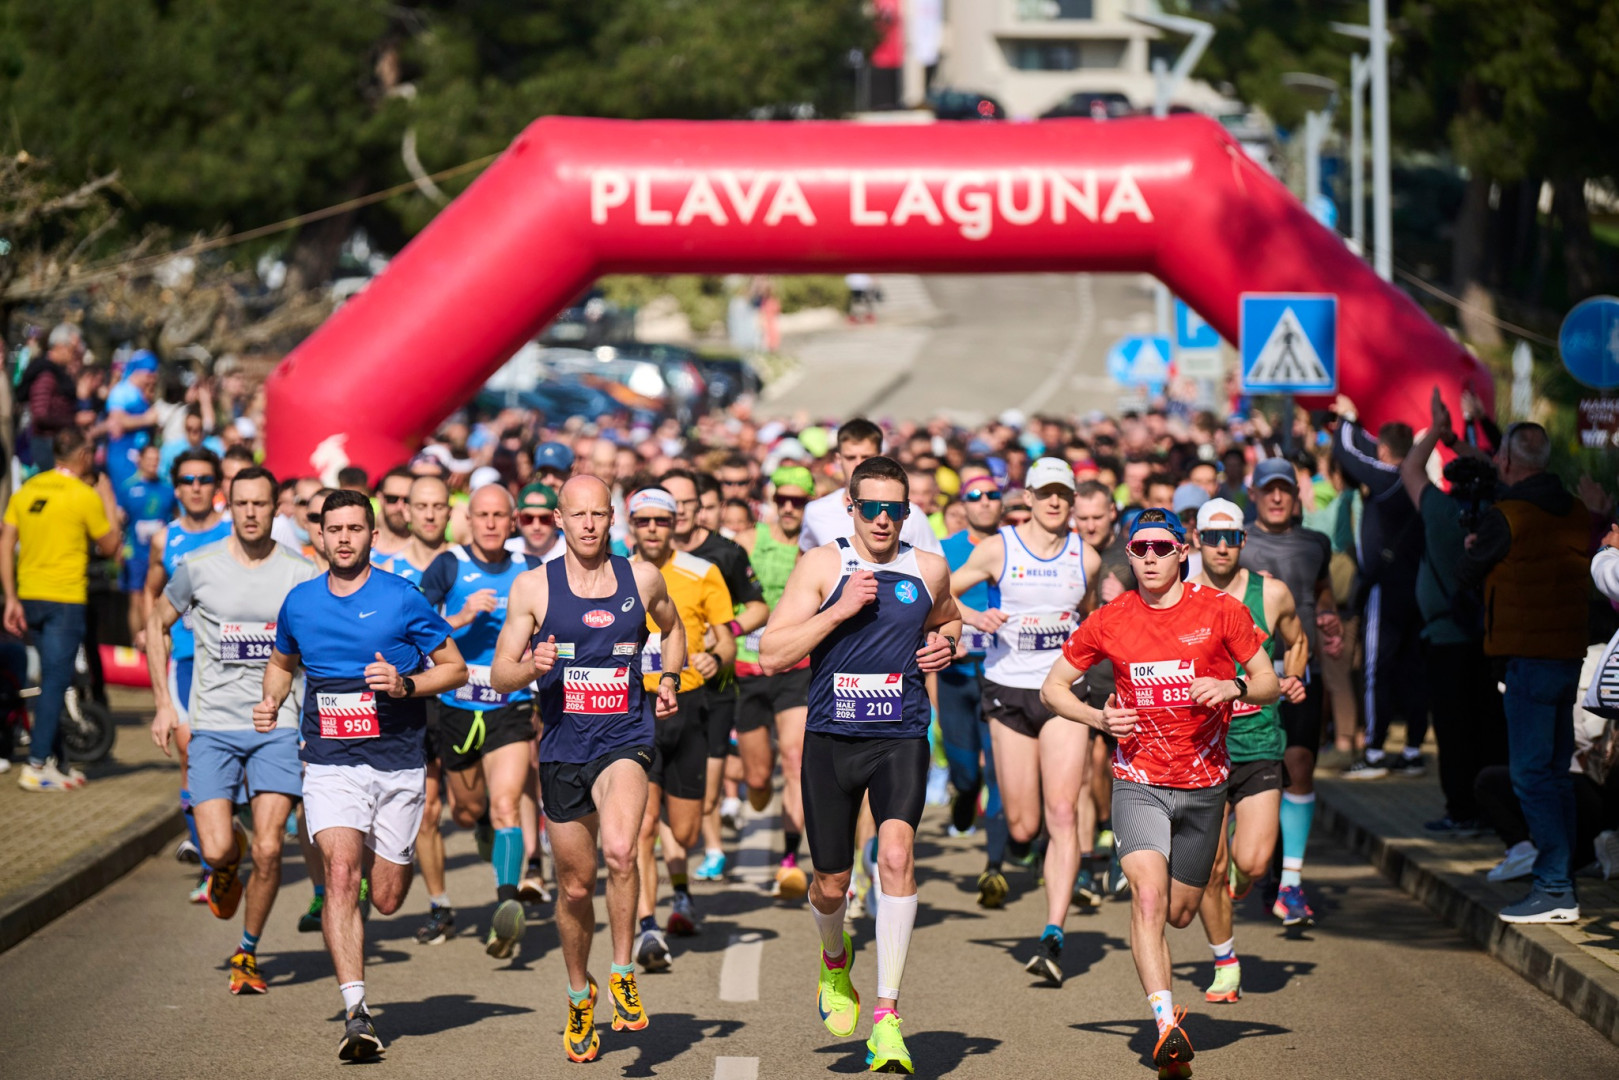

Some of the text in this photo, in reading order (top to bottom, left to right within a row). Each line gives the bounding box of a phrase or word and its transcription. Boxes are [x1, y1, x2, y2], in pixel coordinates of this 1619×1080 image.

[591, 168, 1155, 241] PLAVA LAGUNA
[1026, 569, 1058, 577] HELIOS
[585, 614, 612, 624] Hervis
[1022, 616, 1039, 625] 21K
[224, 624, 241, 632] 21K
[1042, 635, 1065, 648] 354
[246, 644, 272, 657] 336
[568, 670, 590, 680] 10K
[1134, 666, 1155, 676] 10K
[837, 677, 860, 688] 21K
[1162, 688, 1190, 702] 835
[321, 697, 338, 706] 10K
[591, 695, 624, 709] 1007
[866, 702, 893, 716] 210
[836, 711, 856, 719] 2024
[344, 719, 371, 733] 950
